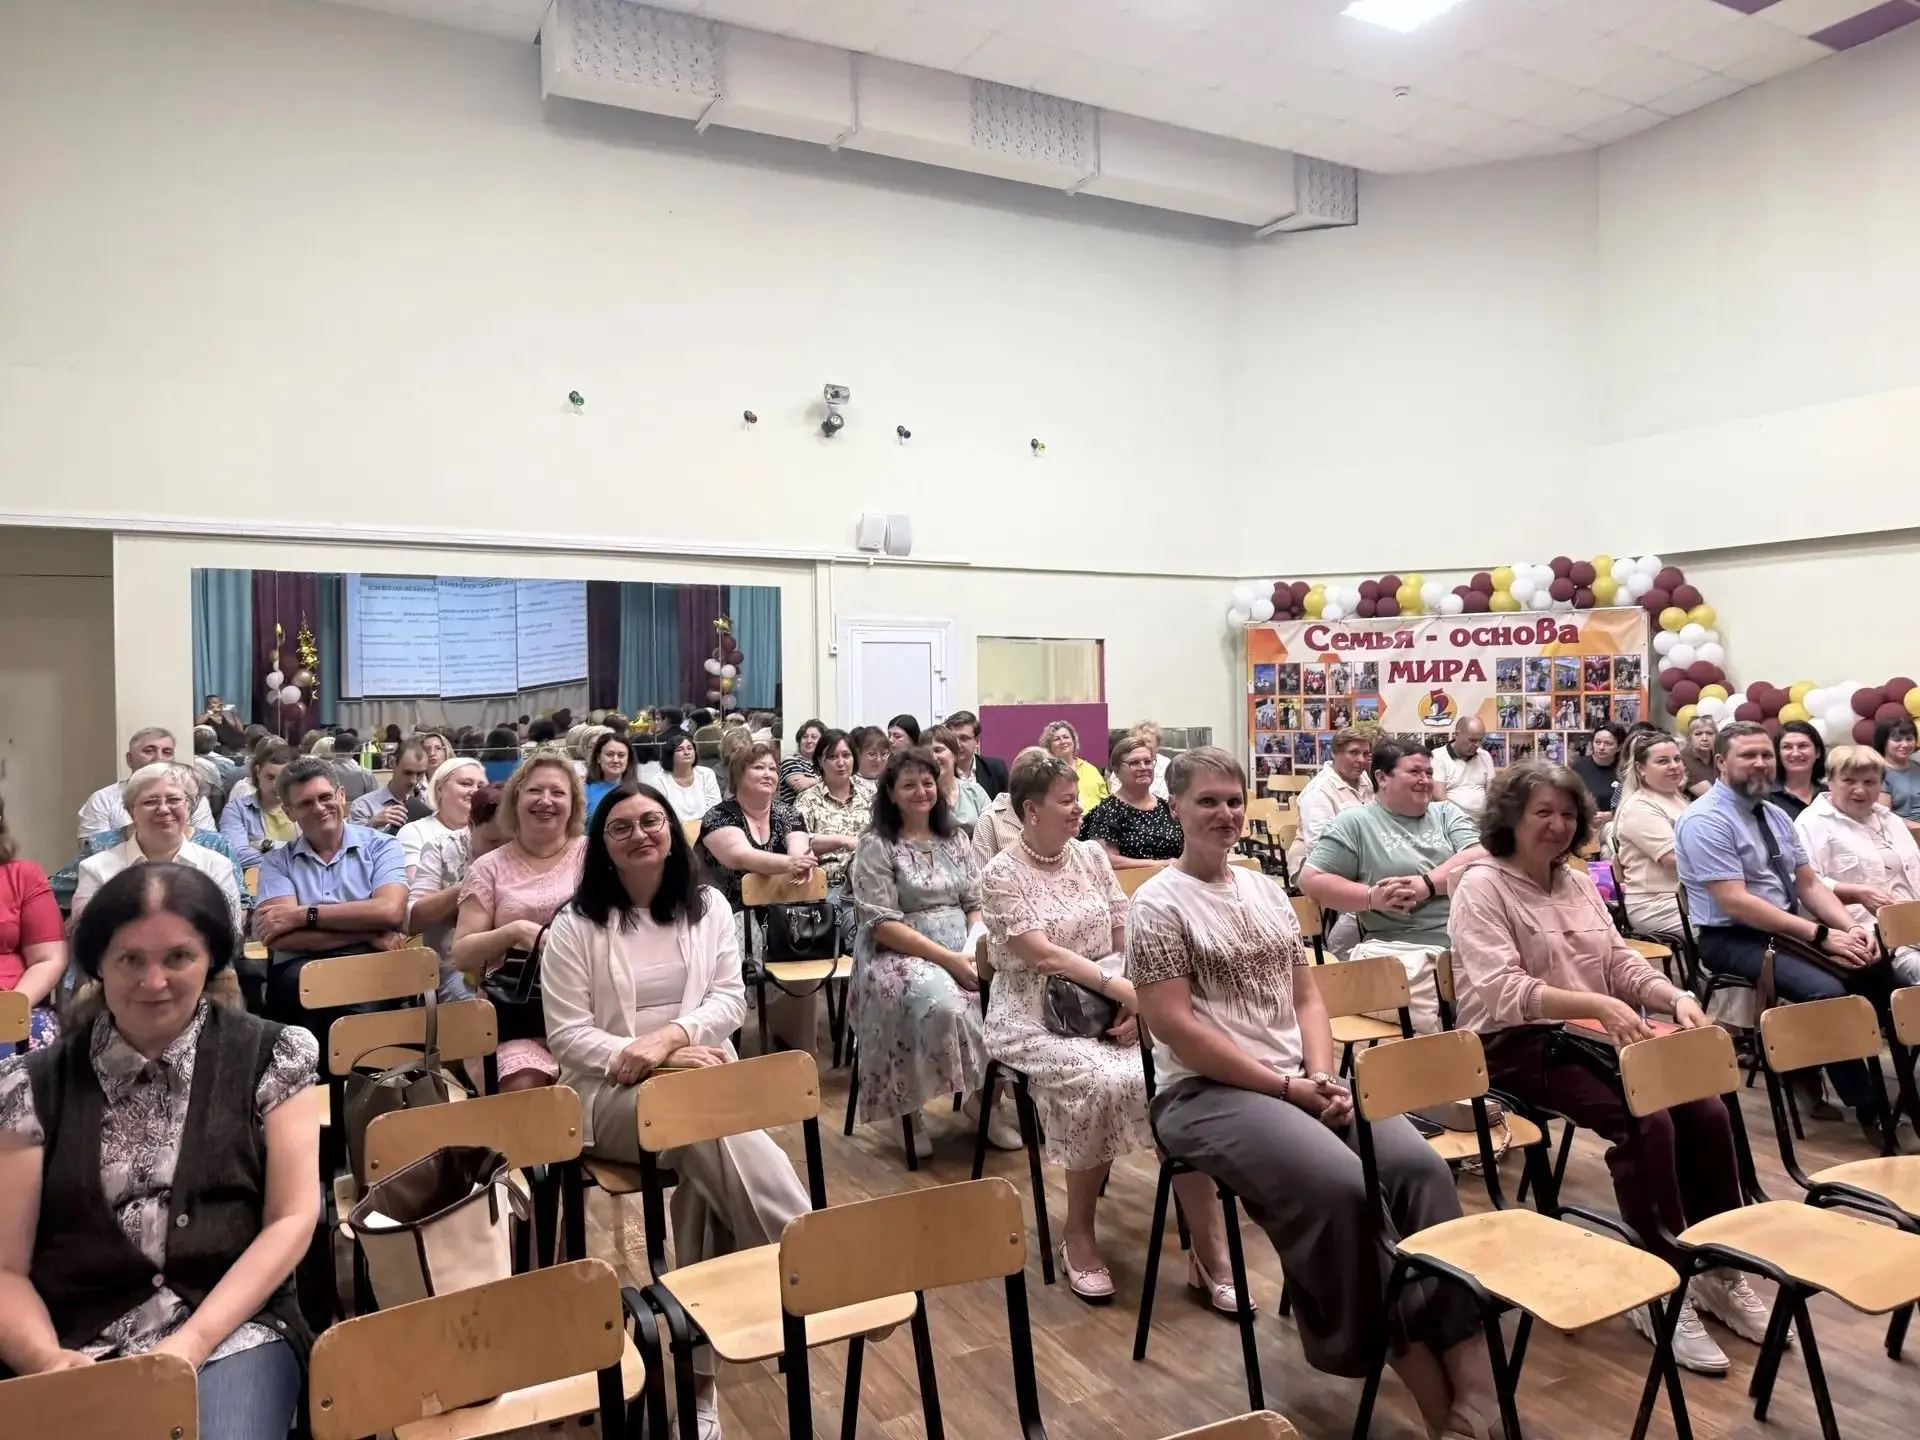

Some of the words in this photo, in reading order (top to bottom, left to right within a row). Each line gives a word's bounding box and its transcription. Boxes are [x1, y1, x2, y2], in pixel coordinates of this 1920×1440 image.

[1303, 624, 1415, 652] Семья
[1426, 634, 1438, 642] -
[1449, 617, 1581, 648] основа
[1387, 658, 1487, 684] МИРА
